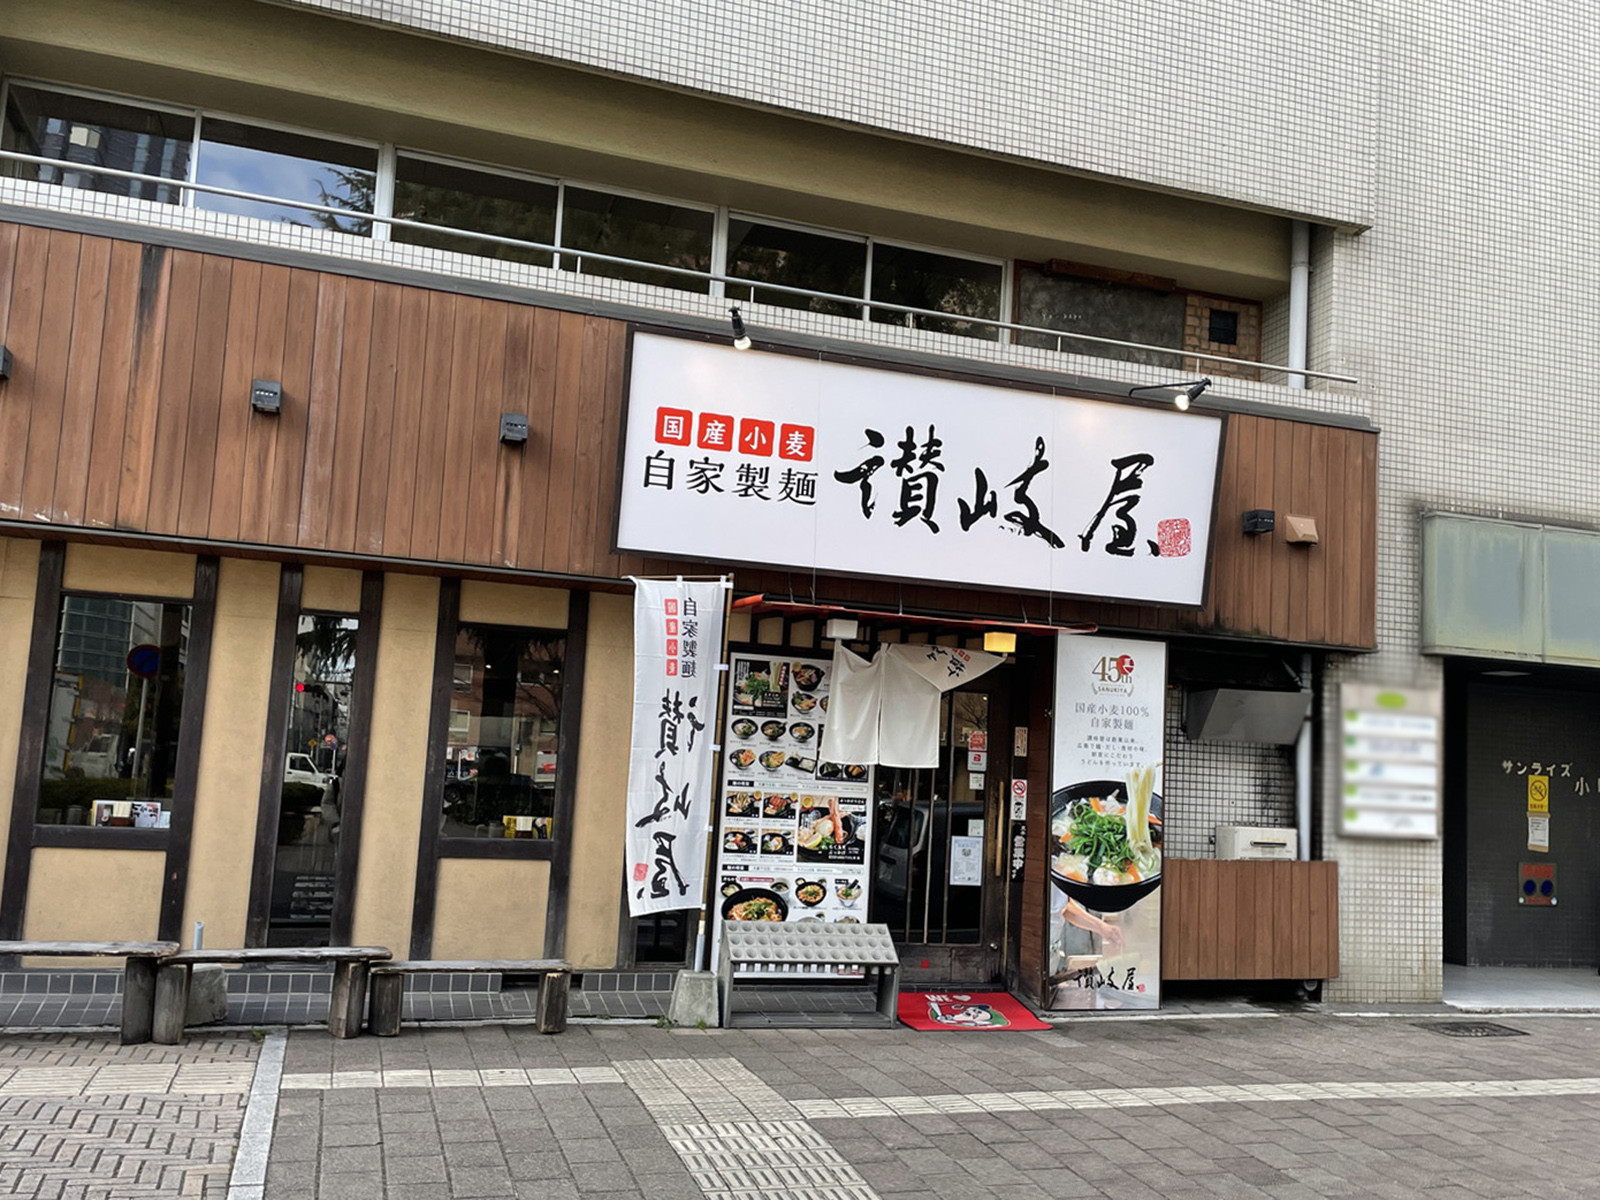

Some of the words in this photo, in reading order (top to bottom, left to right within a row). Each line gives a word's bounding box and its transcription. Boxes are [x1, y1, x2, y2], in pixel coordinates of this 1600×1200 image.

[660, 413, 810, 458] 国産小麦
[643, 449, 819, 505] 自家製麺
[833, 423, 1159, 557] 讃岐屋
[1090, 717, 1134, 730] 自家製麺
[1502, 760, 1573, 777] サンライズ
[1574, 777, 1600, 796] 小
